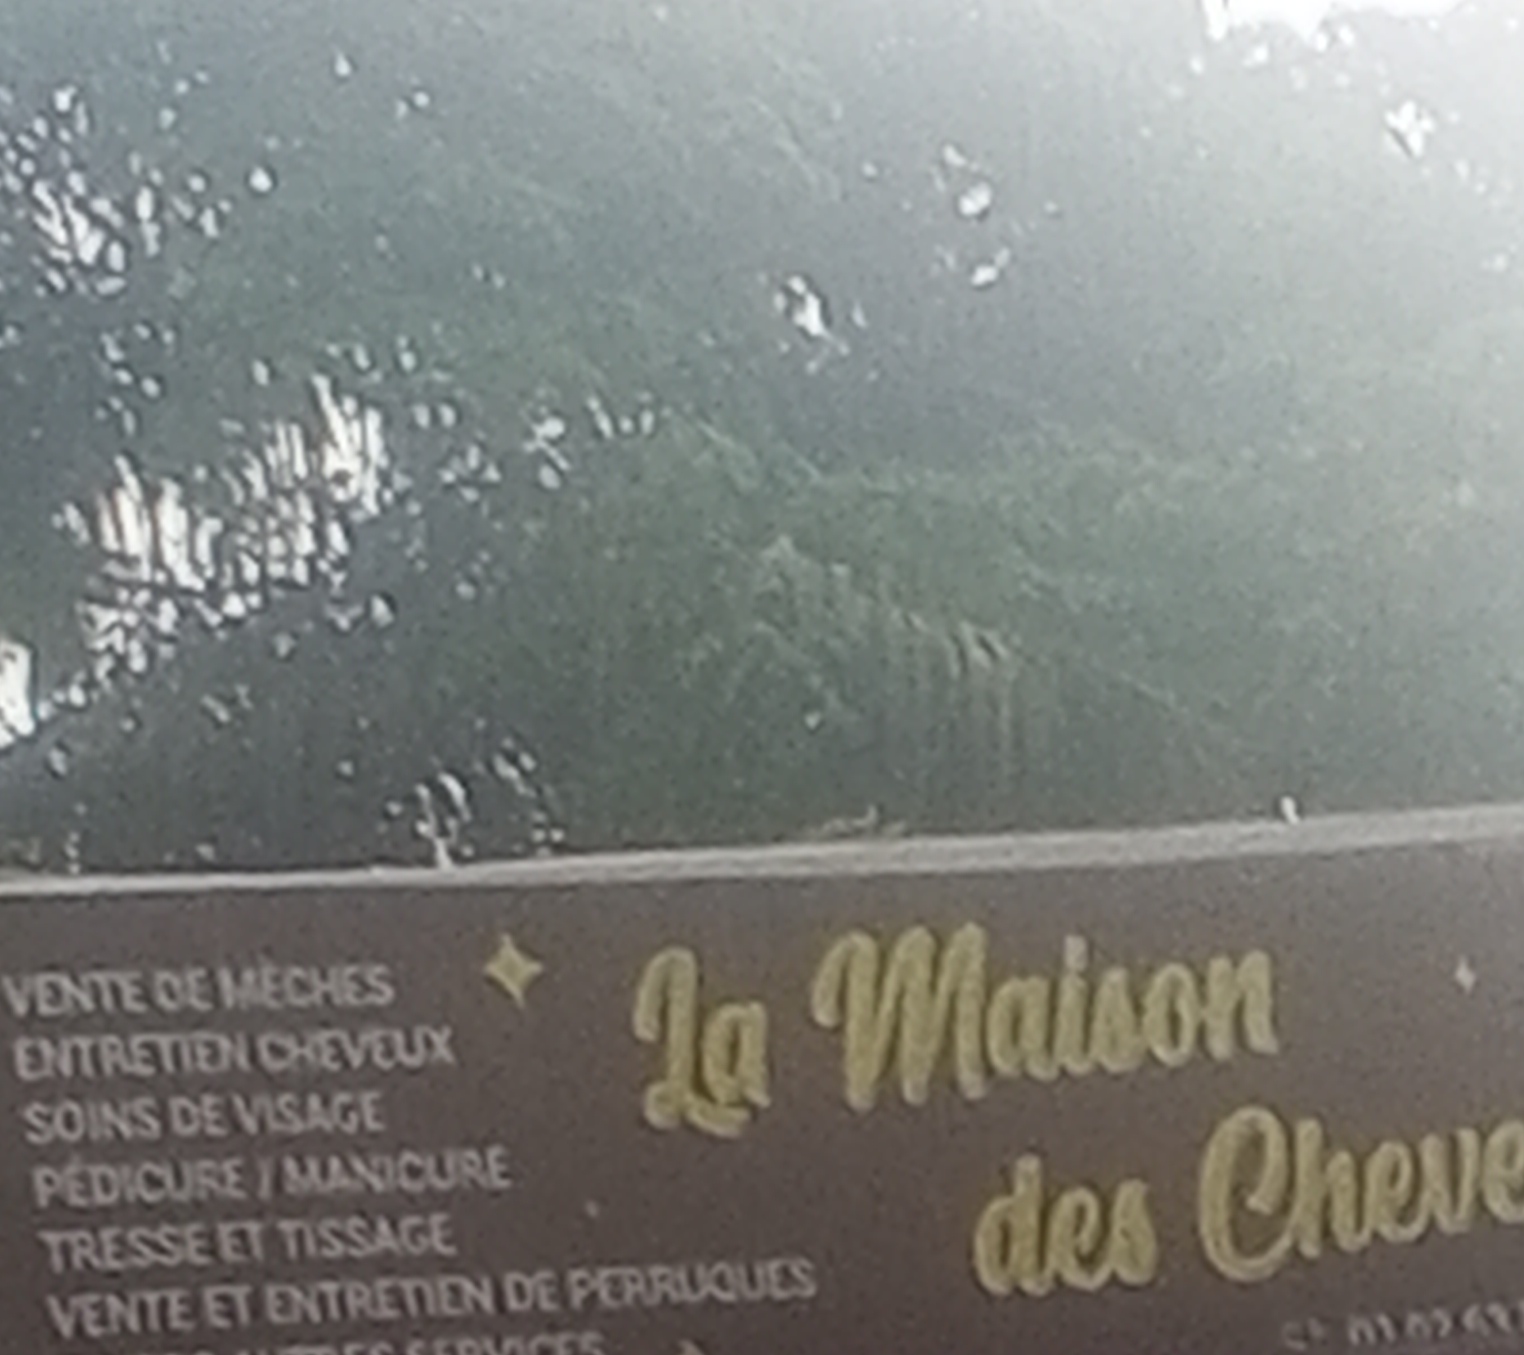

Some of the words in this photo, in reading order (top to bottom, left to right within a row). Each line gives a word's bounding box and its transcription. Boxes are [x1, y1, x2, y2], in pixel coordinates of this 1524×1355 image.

[2, 968, 147, 1018] VENTE
[154, 967, 214, 1014] DE
[12, 1031, 250, 1082] ENTRETIEN
[255, 1025, 458, 1073] CHEVEUX
[632, 945, 771, 1139] La
[810, 921, 1279, 1112] Maison
[22, 1095, 162, 1145] SOINS
[169, 1094, 228, 1137] DE
[233, 1090, 387, 1135] VISAGE
[283, 1145, 513, 1199] MANICURE
[38, 1224, 210, 1274] TRESSE
[220, 1219, 268, 1265] ET
[276, 1212, 459, 1261] TISSAGE
[974, 1154, 1158, 1297] des
[45, 1287, 195, 1341] VENTE
[203, 1283, 260, 1328] ET
[266, 1275, 495, 1327] ENTRETIEN
[505, 1270, 559, 1314] DE
[569, 1257, 819, 1310] PERRUQUES
